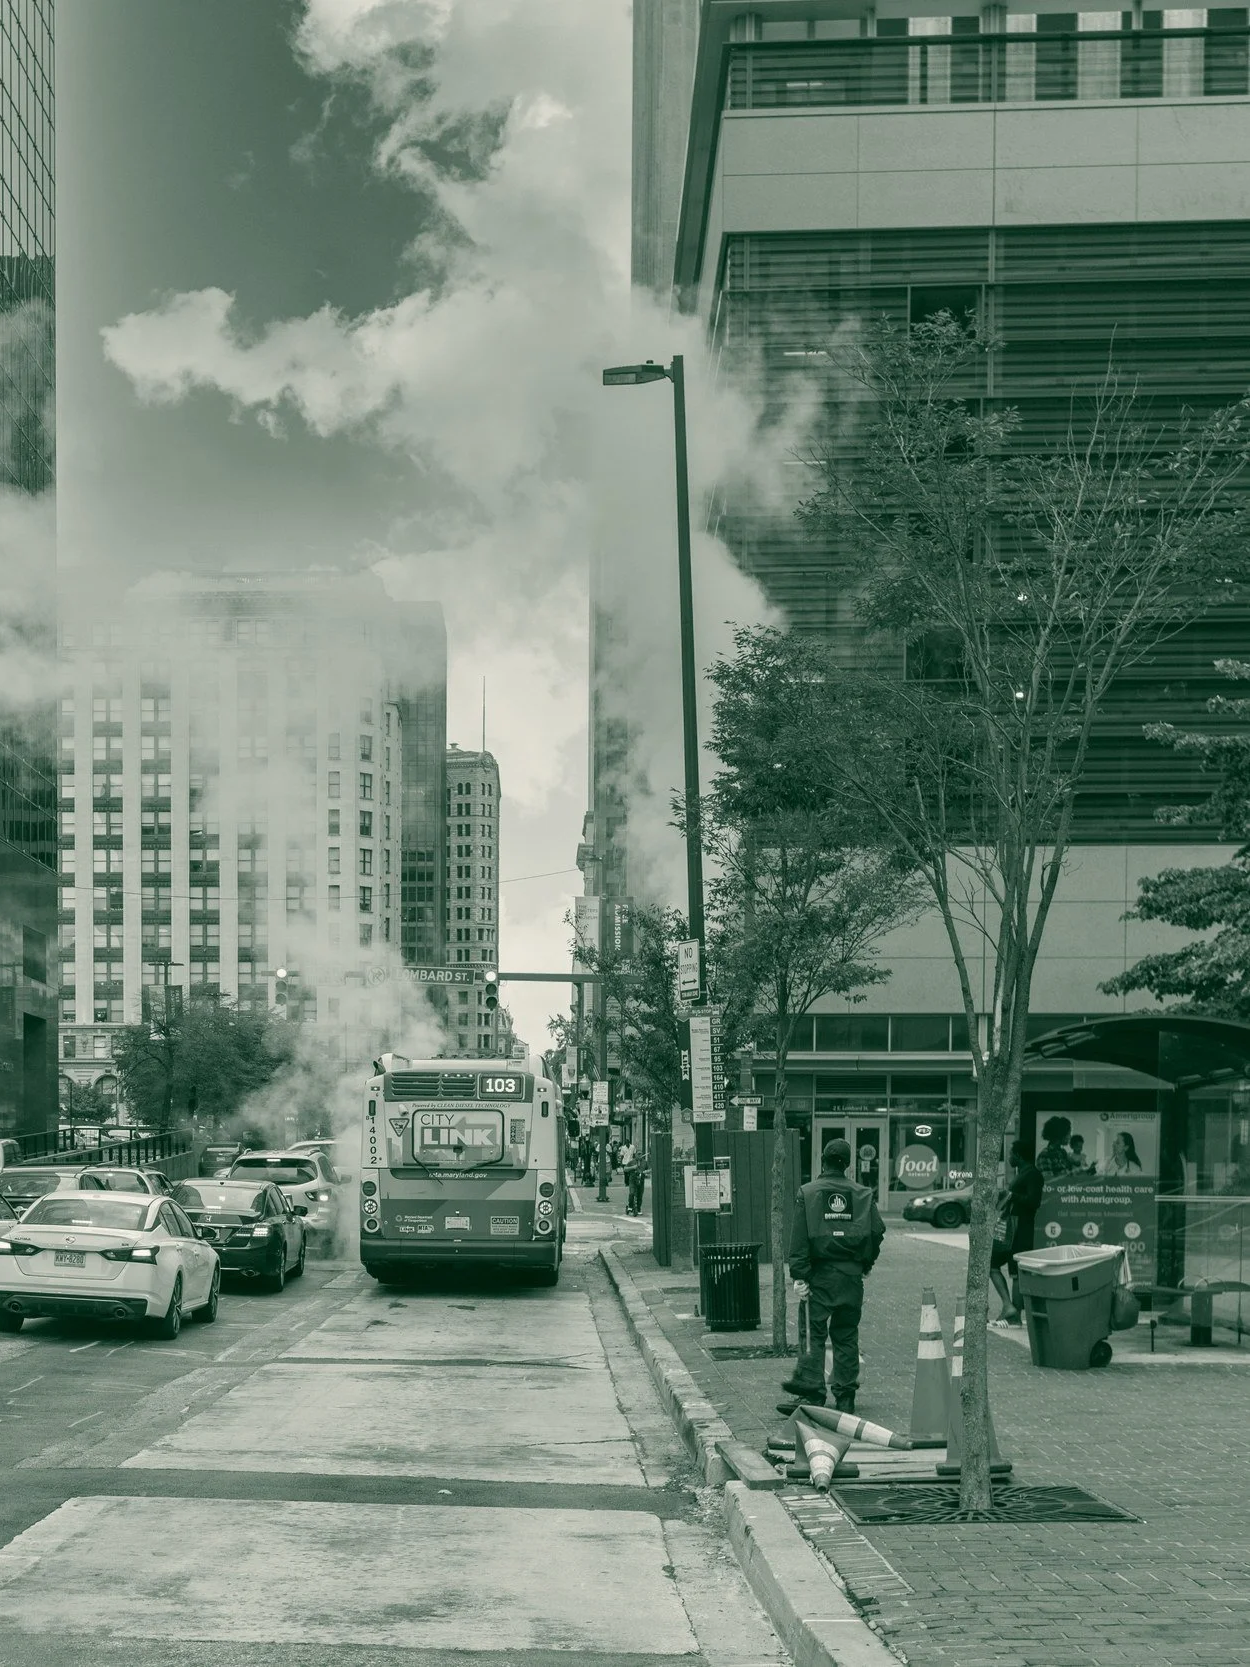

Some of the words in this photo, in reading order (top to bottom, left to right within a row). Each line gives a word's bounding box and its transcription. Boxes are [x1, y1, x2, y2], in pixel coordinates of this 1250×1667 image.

[685, 948, 692, 959] NO
[396, 967, 452, 981] LOMBARD
[455, 971, 470, 981] ST.
[486, 1078, 516, 1093] 103
[421, 1114, 455, 1125] CITY
[1110, 1112, 1156, 1120] Amerigroup
[424, 1128, 494, 1145] LINK
[898, 1154, 938, 1178] food
[949, 1170, 972, 1179] Corona
[1067, 1185, 1104, 1193] low-cost
[1106, 1185, 1132, 1193] health
[1080, 1196, 1132, 1204] Amerigroup.
